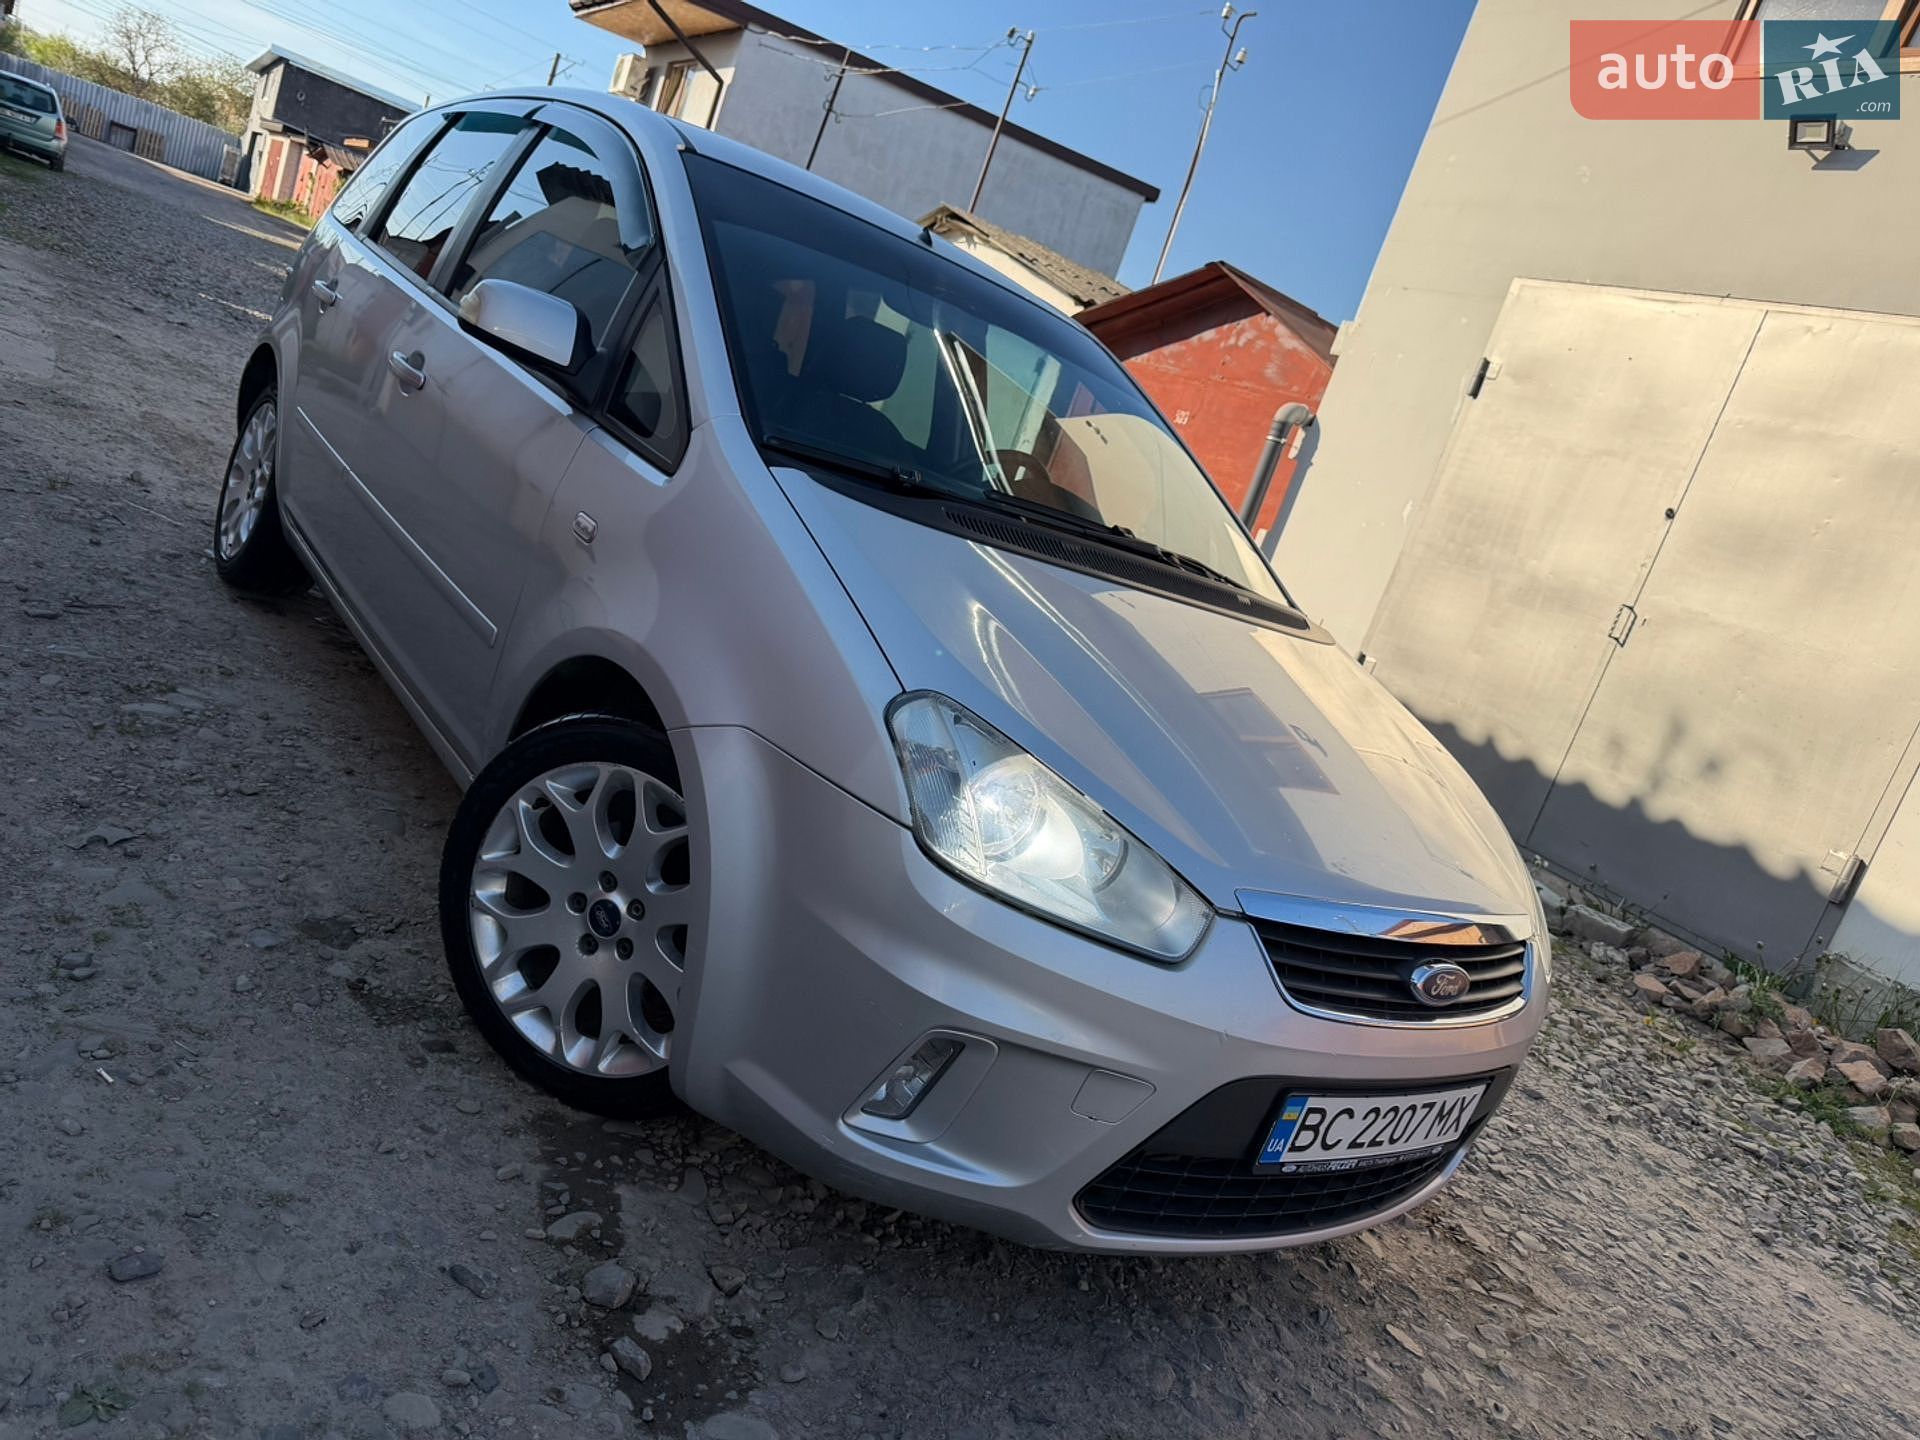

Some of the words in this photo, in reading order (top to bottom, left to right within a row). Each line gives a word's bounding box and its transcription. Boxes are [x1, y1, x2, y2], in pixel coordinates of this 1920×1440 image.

[1430, 973, 1462, 996] Ford
[1286, 1106, 1355, 1153] BC
[1266, 1138, 1285, 1153] UA
